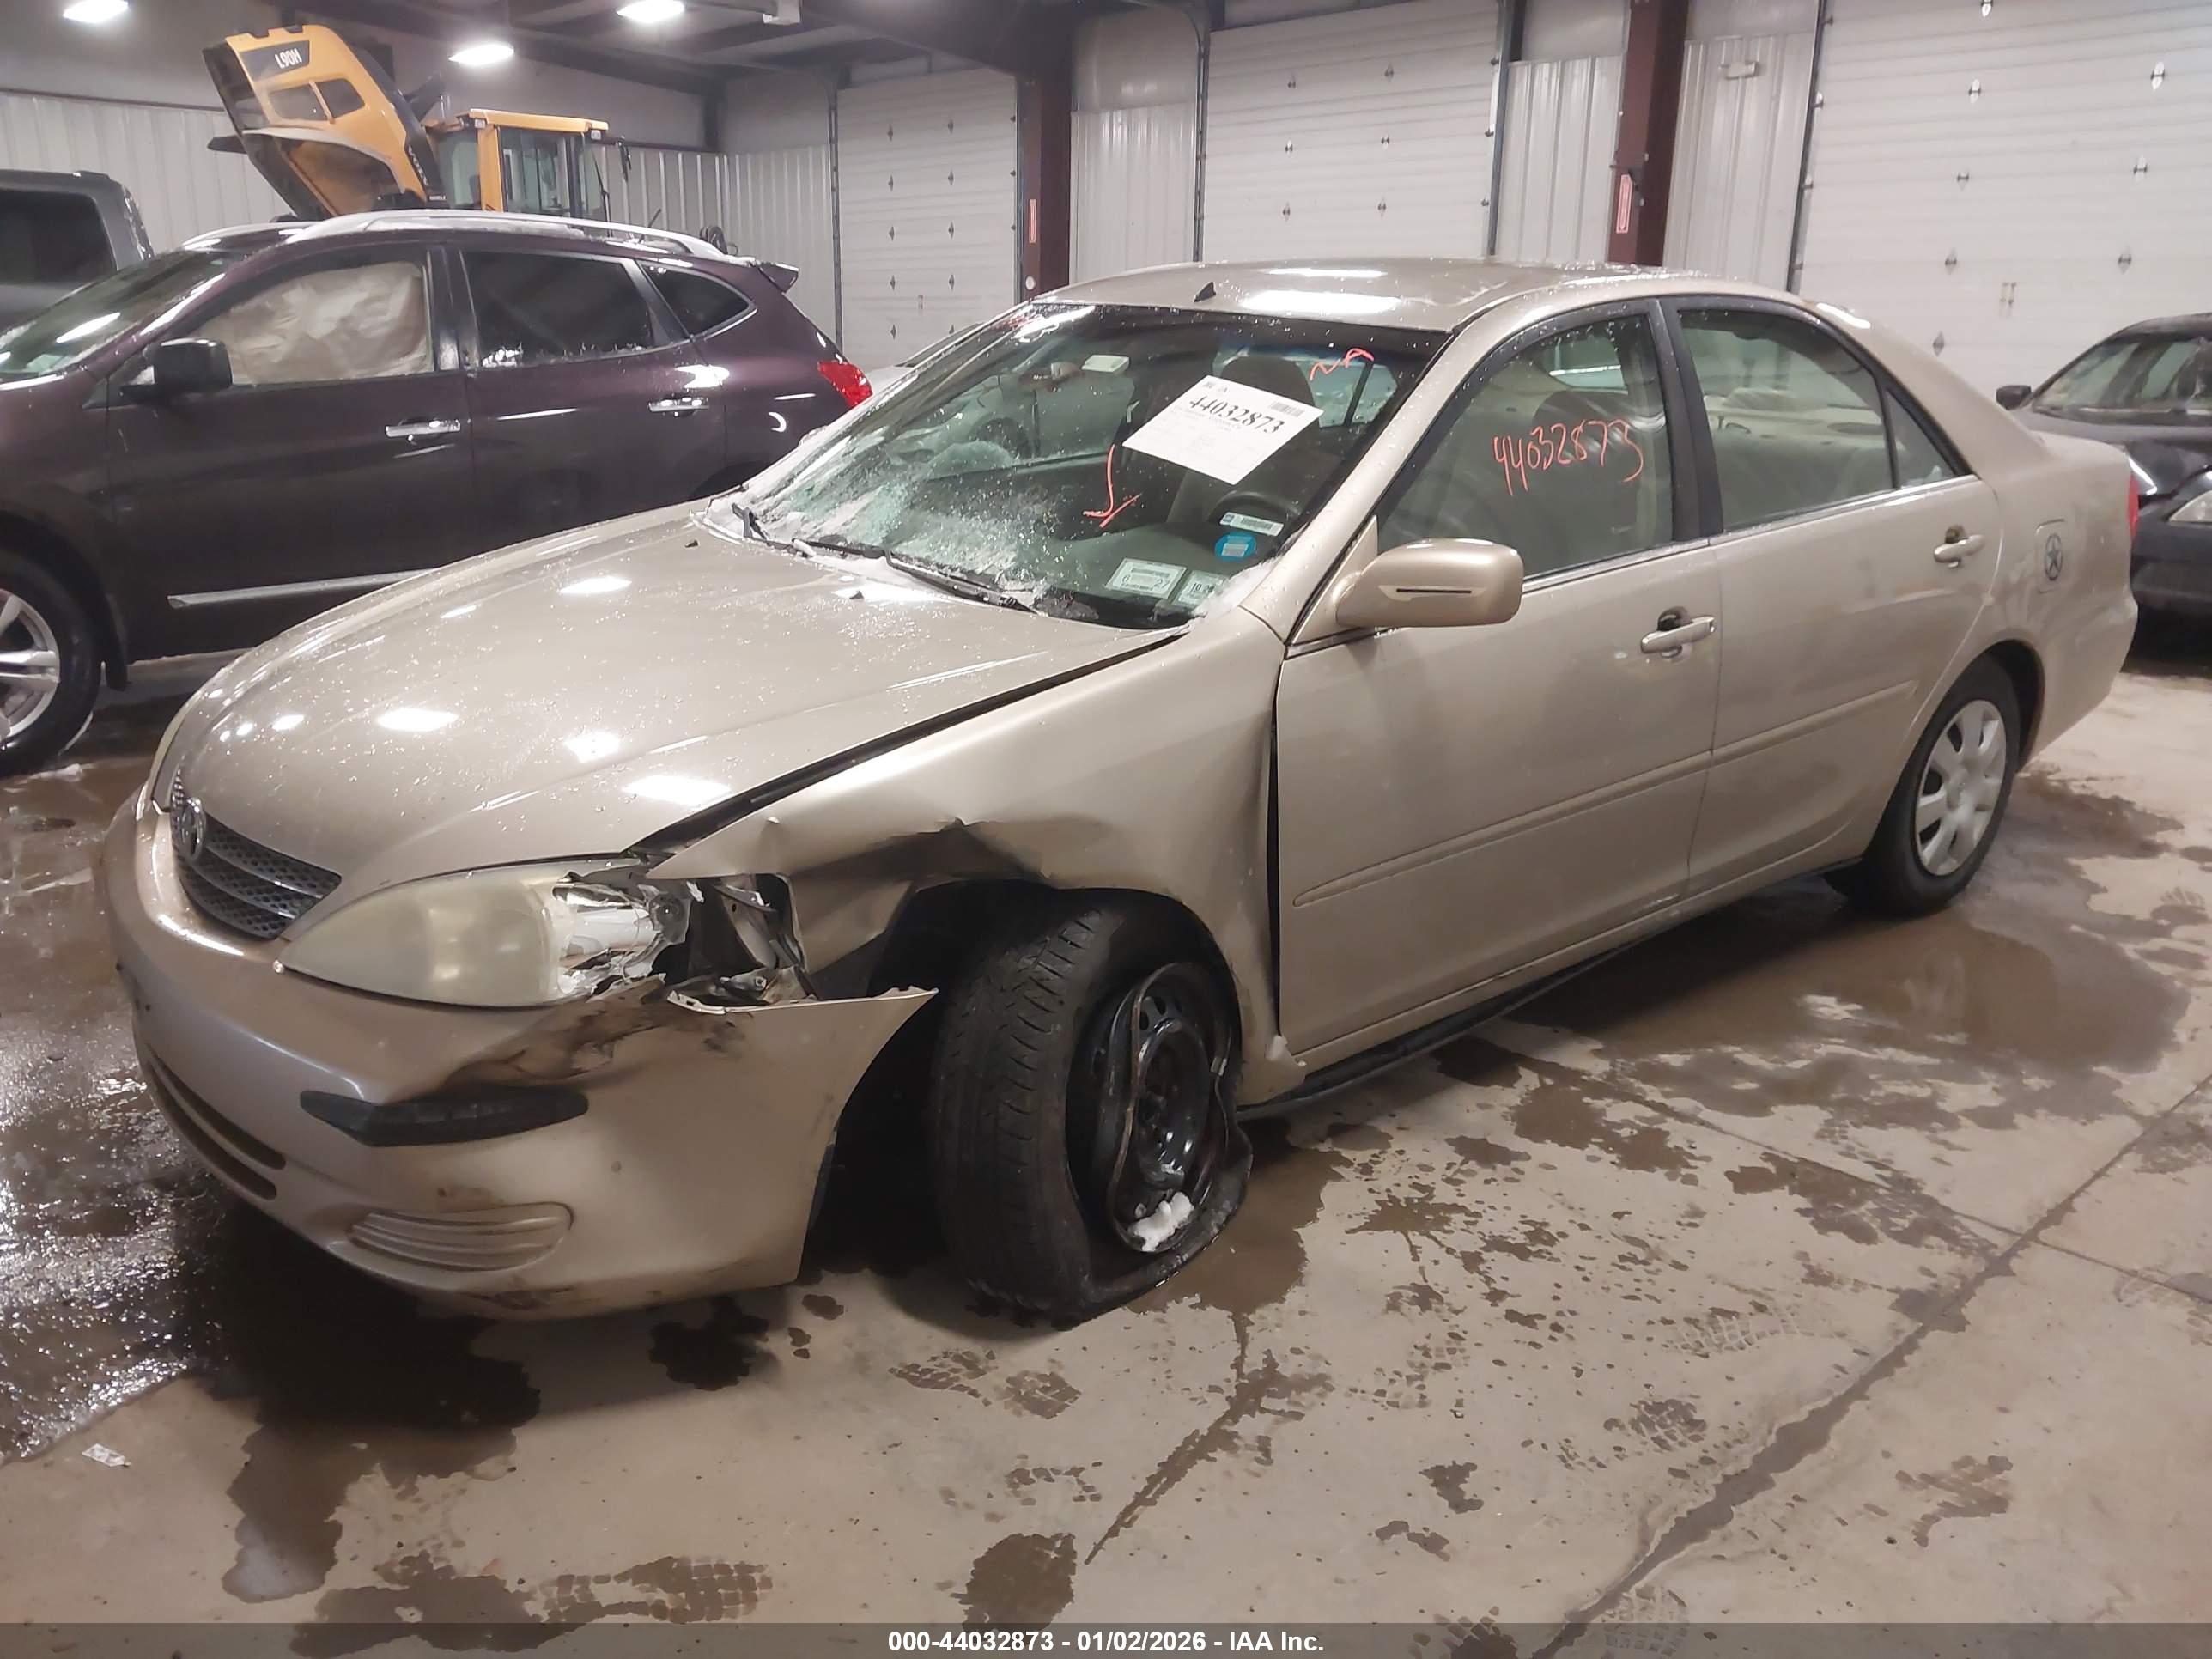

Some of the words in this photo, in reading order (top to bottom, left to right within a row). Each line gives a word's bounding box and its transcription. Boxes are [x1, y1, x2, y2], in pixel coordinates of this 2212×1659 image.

[274, 48, 302, 69] L90H
[1190, 395, 1285, 433] 44032873
[1492, 419, 1644, 495] 44032873
